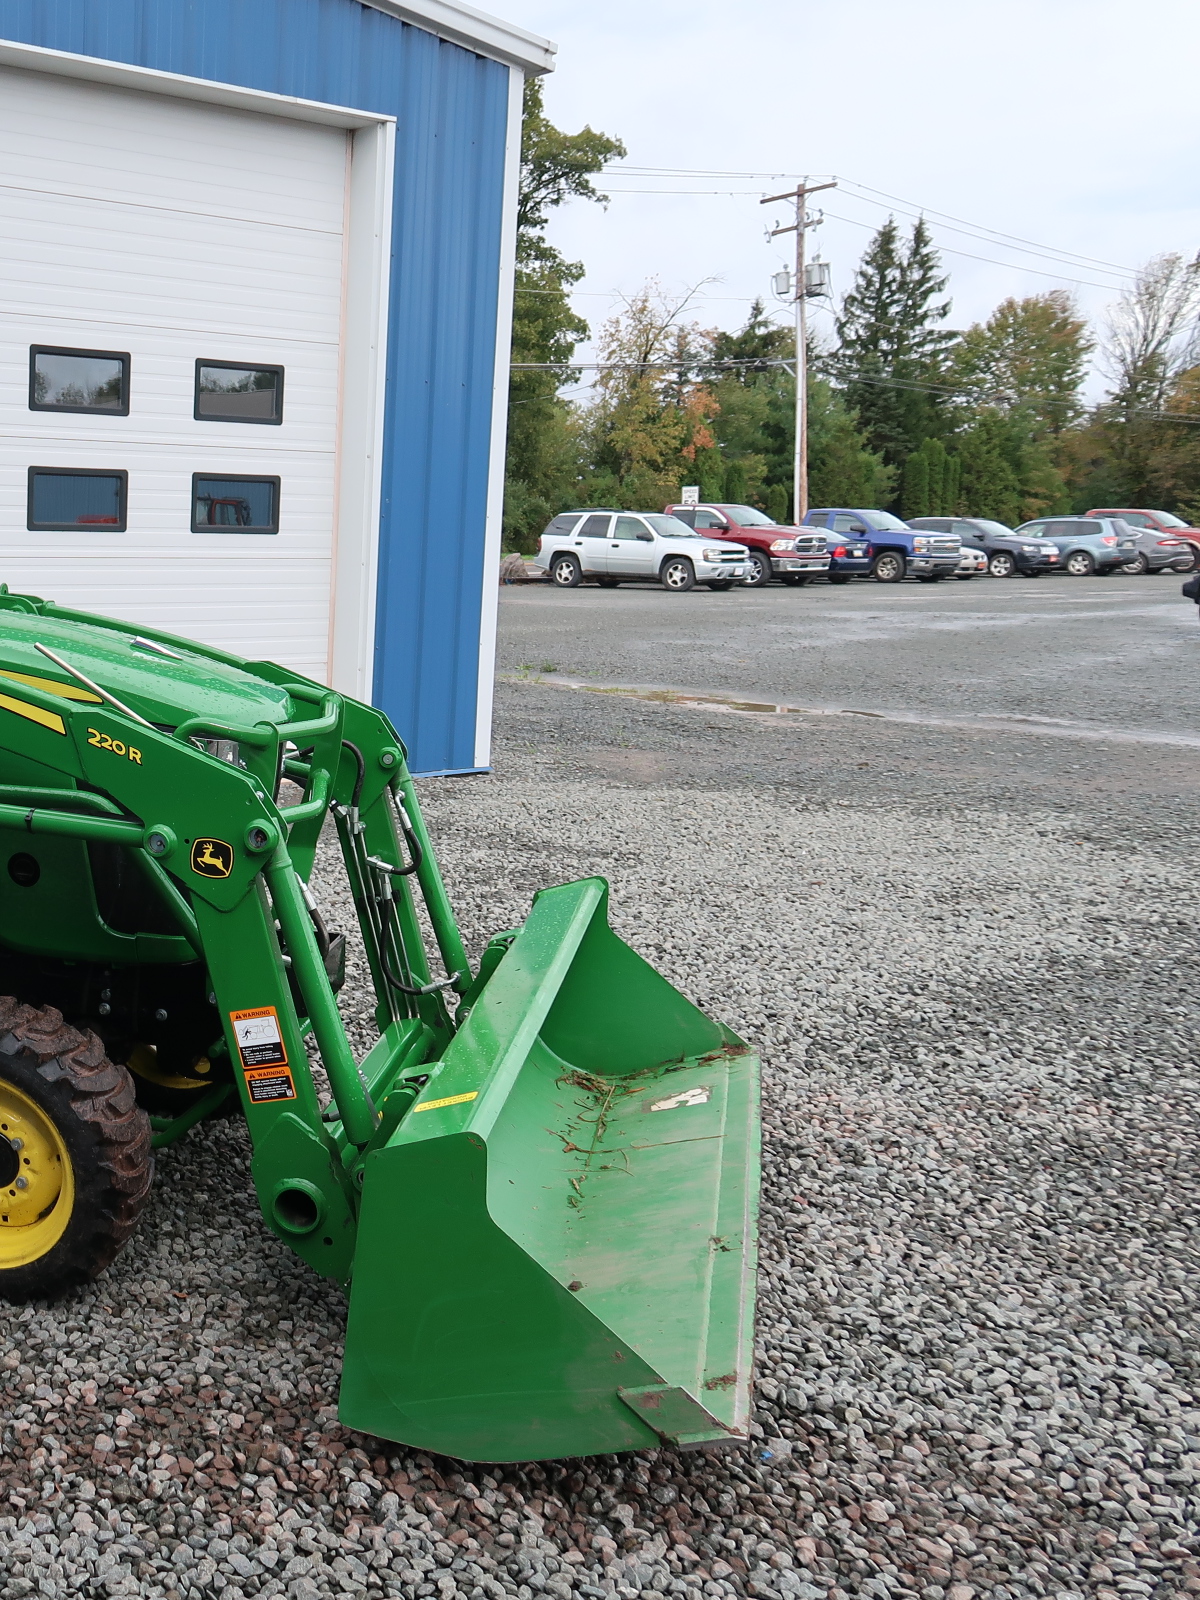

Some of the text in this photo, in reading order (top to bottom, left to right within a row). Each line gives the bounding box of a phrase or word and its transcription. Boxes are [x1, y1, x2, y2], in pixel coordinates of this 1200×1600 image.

[87, 727, 127, 756] 220
[241, 1010, 271, 1018] WARNING
[257, 1070, 286, 1078] WARNING
